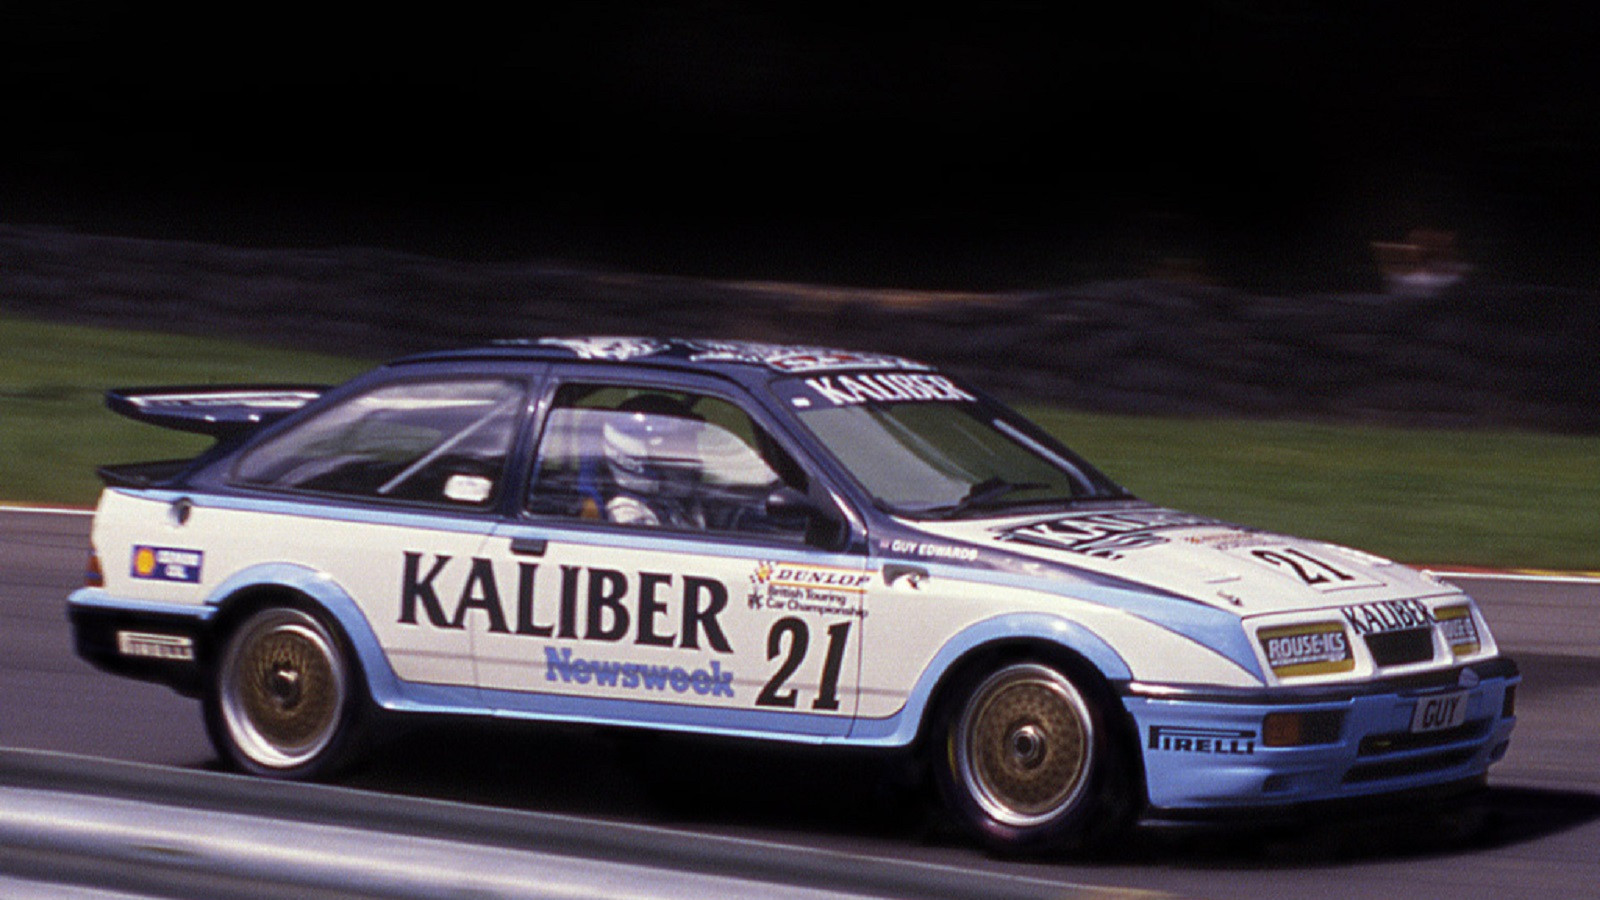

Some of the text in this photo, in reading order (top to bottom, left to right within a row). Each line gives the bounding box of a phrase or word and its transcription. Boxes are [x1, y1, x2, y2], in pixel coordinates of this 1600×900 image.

[805, 374, 977, 405] KALIBER
[892, 540, 979, 561] GUY EDWARDS
[776, 569, 871, 587] DUNLOP
[1251, 548, 1356, 584] 21
[397, 551, 735, 655] KALIBER
[766, 598, 869, 618] Car Championship
[767, 585, 848, 606] British Touring
[1340, 598, 1436, 635] KALIBER
[544, 646, 735, 698] Newsweek
[755, 615, 853, 710] 21
[1422, 697, 1461, 727] GUY
[1147, 725, 1256, 755] PIRELLI
